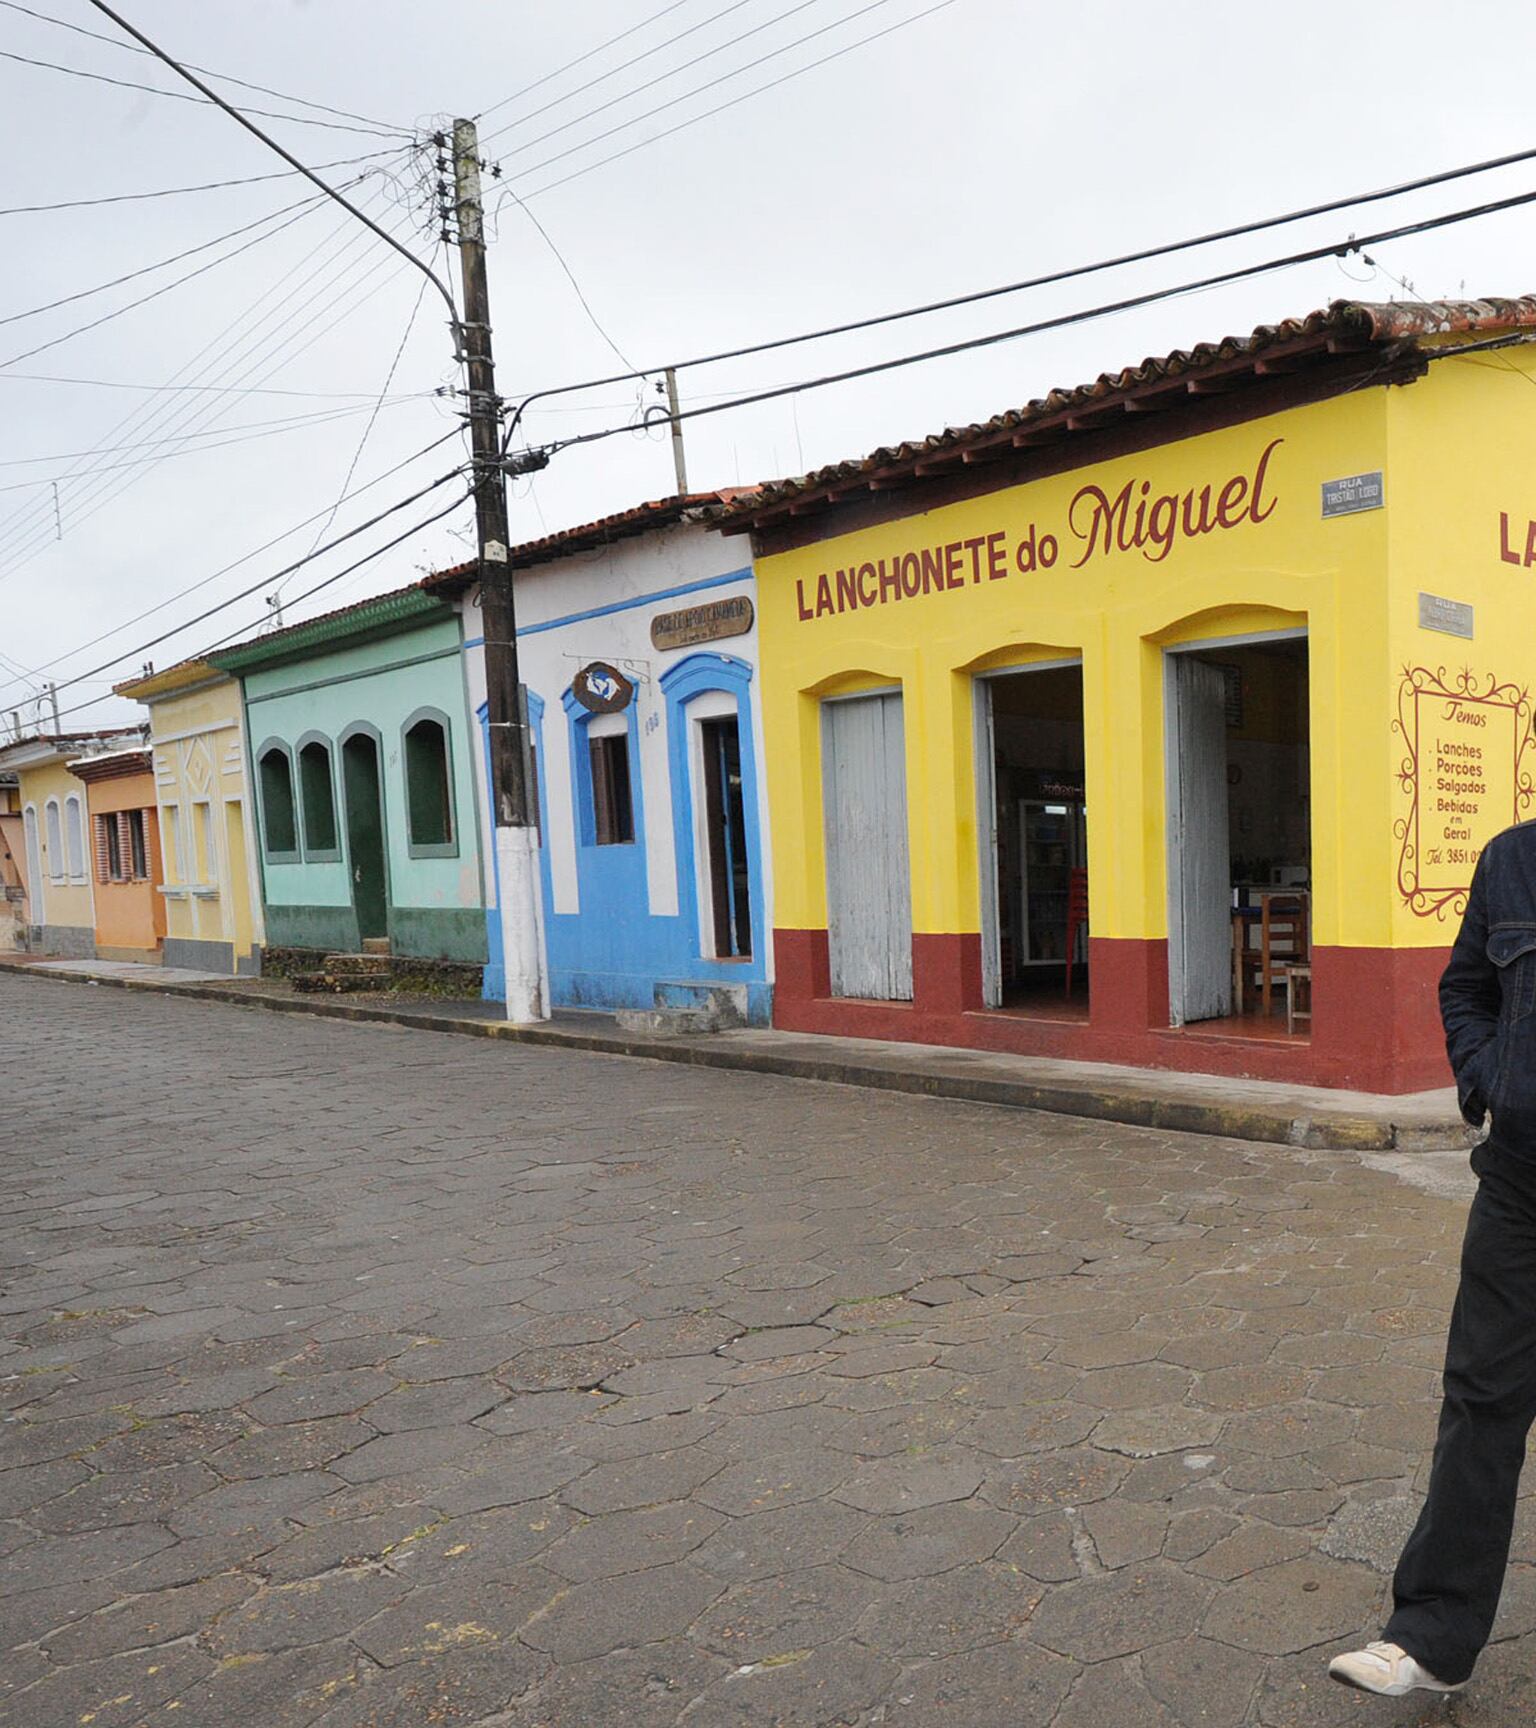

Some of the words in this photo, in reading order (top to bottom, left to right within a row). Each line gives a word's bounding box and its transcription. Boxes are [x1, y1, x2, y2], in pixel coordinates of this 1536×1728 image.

[1339, 478, 1362, 489] RUA
[796, 531, 1008, 622] LANCHONETE
[1015, 523, 1059, 574] do
[1068, 438, 1285, 569] Miguel
[1441, 701, 1487, 727] Temos
[1436, 738, 1482, 759] Lanches
[1436, 758, 1482, 777] Porções
[1436, 778, 1486, 796] Salgados
[1436, 798, 1478, 814] Bebidas
[1443, 827, 1471, 840] Geral
[1447, 849, 1468, 864] 3851
